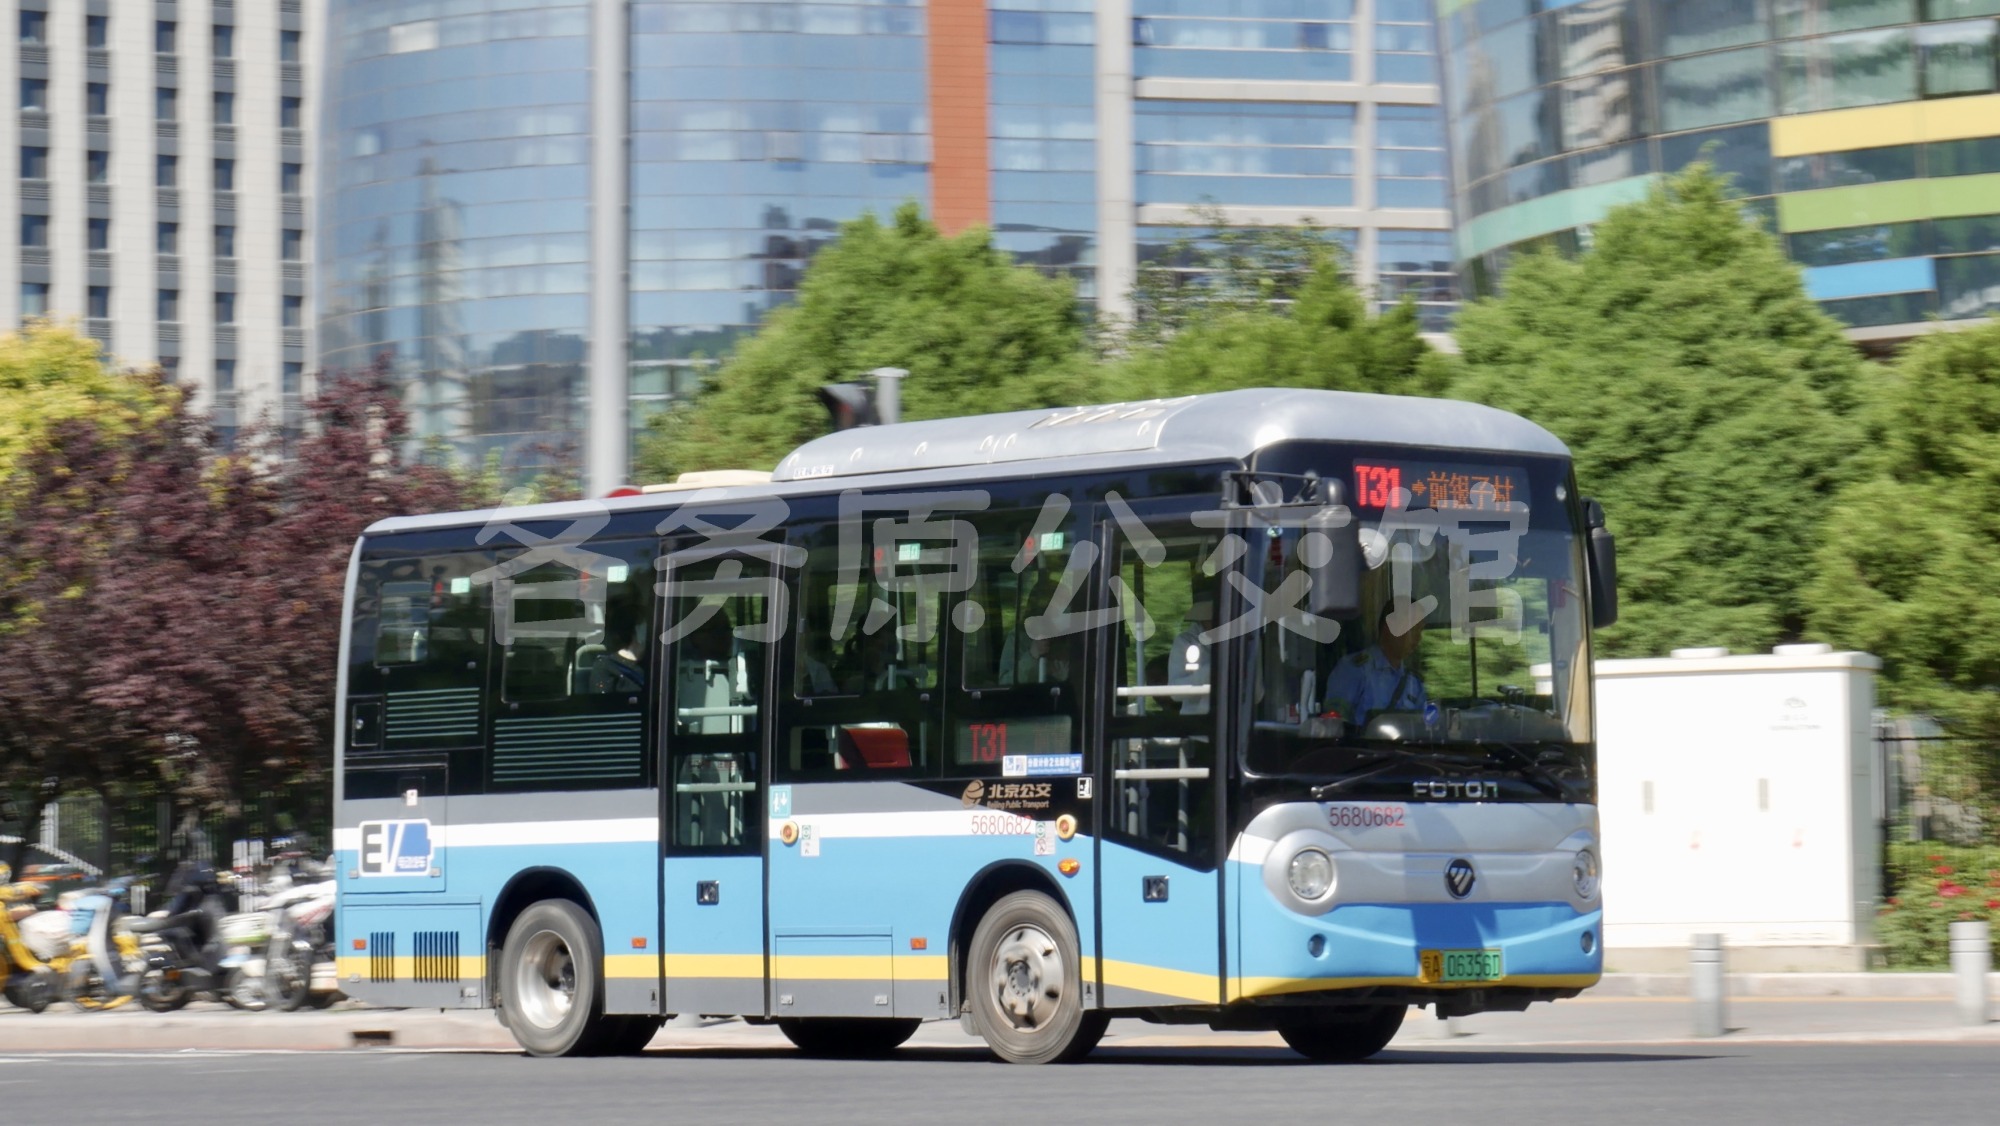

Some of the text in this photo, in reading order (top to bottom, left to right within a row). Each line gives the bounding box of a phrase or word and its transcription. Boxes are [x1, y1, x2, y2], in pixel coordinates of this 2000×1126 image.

[1355, 465, 1514, 512] T31 前银子村
[968, 723, 1007, 763] T31
[988, 783, 1052, 799] 北京公交
[1412, 781, 1498, 798] FOTON
[986, 800, 1050, 810] Beijing Public Transport
[971, 815, 1033, 835] 5680682
[1329, 806, 1405, 828] 5680682
[362, 823, 406, 873] EV
